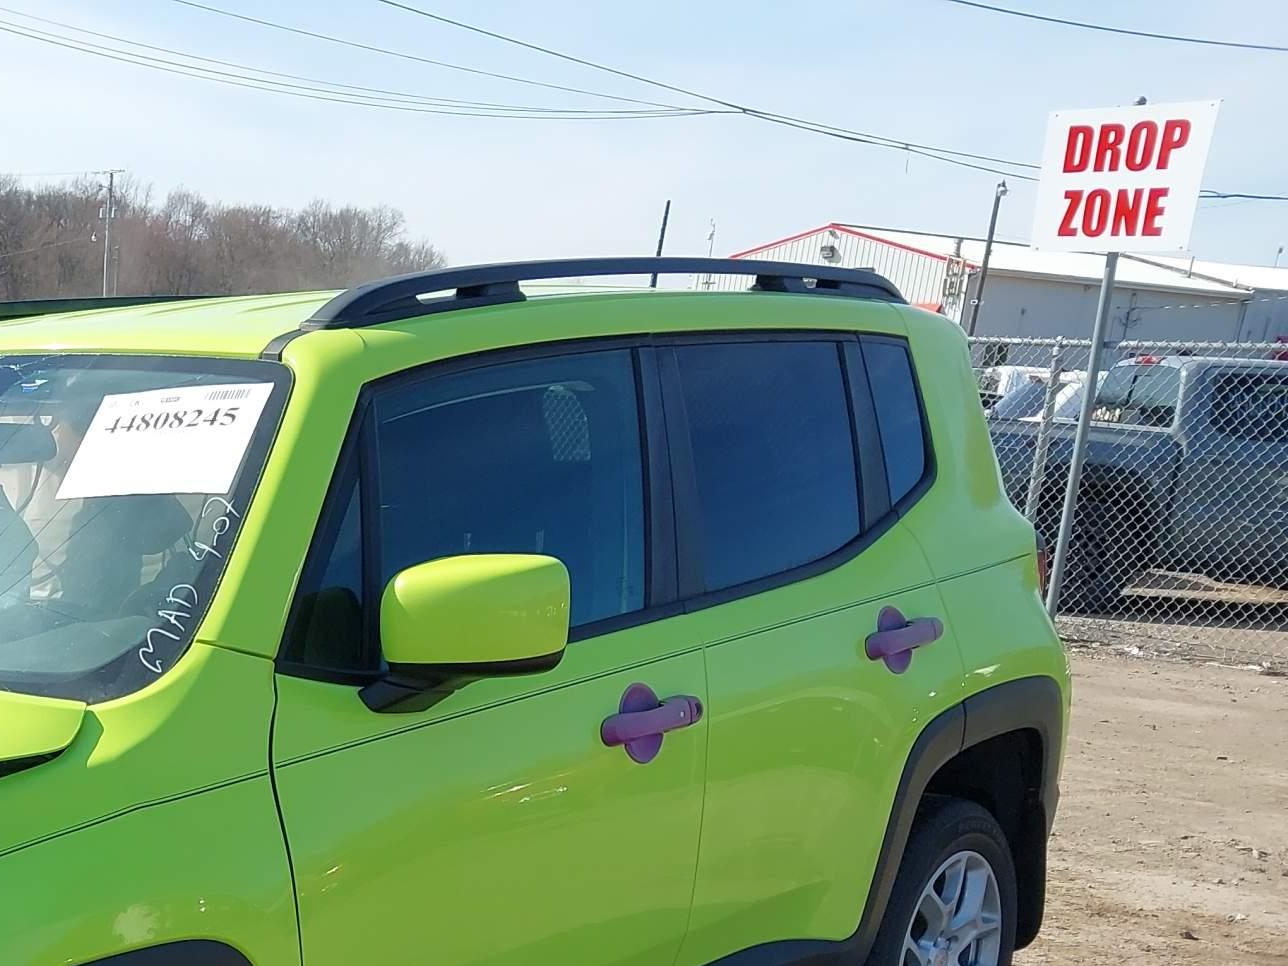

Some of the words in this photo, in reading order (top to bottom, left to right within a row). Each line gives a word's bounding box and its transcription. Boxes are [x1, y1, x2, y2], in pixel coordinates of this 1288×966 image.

[1062, 118, 1192, 174] DROP
[1057, 187, 1170, 238] ZONE
[104, 407, 241, 434] 44808245
[138, 583, 199, 673] MAD
